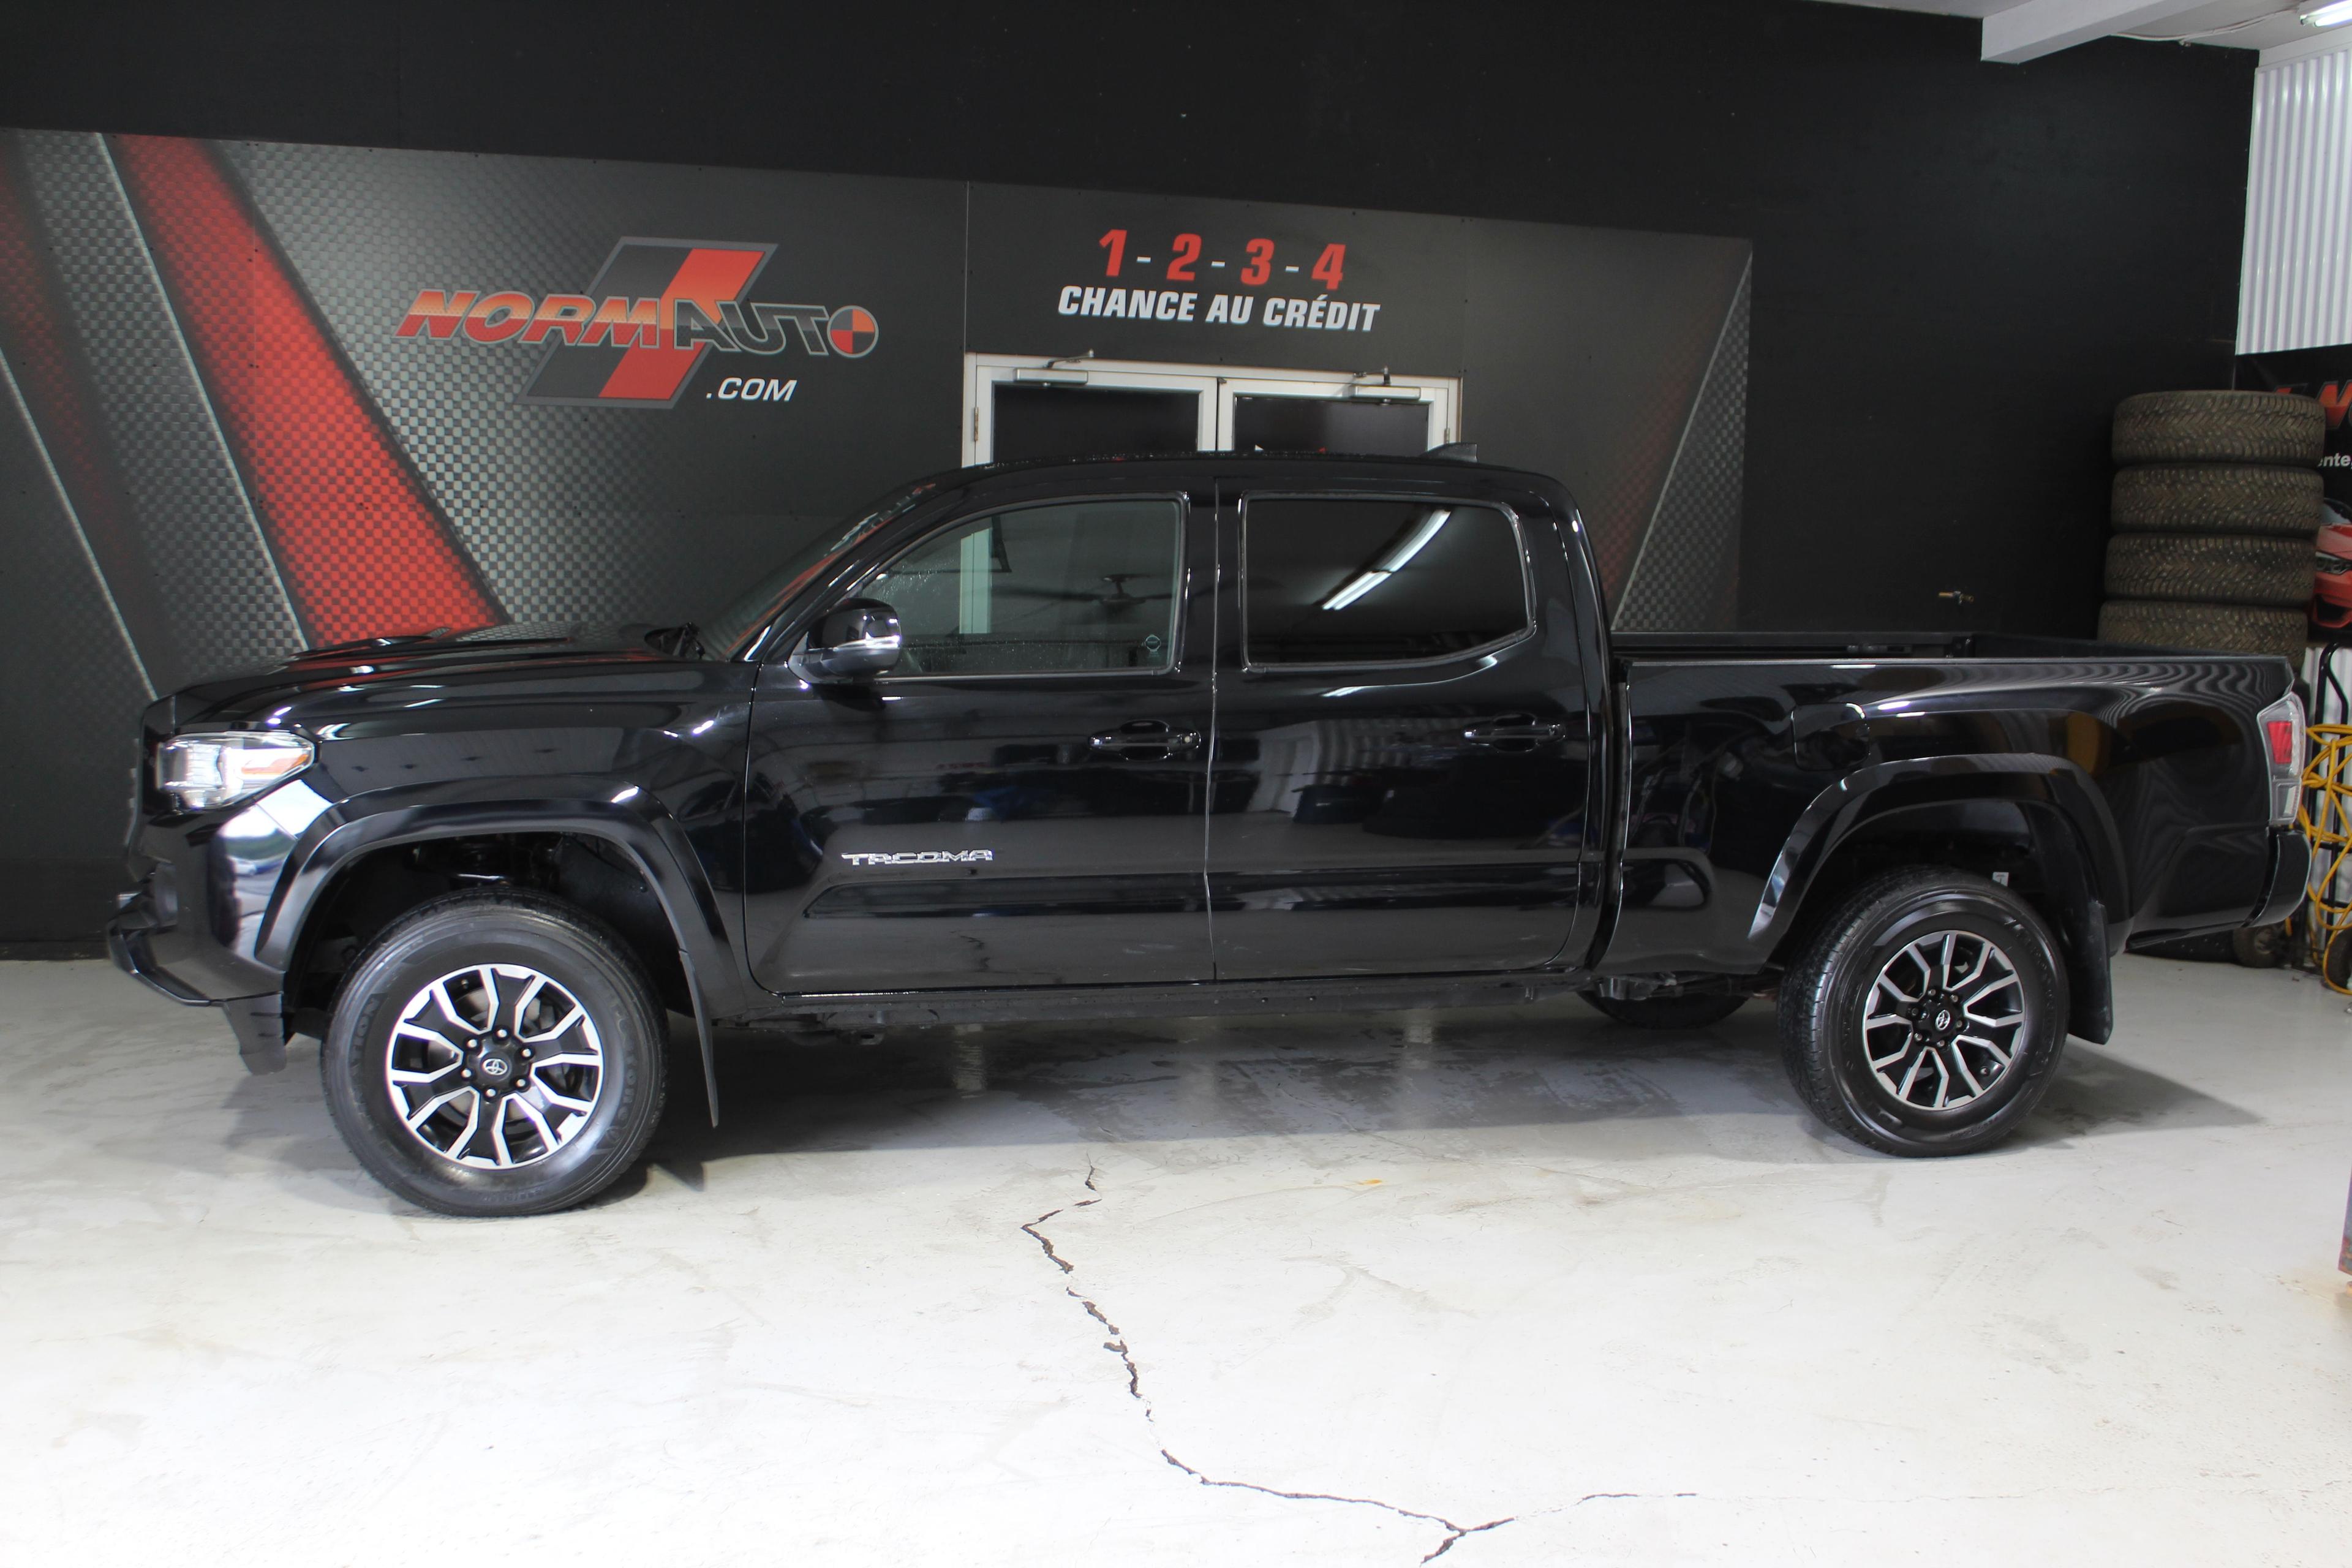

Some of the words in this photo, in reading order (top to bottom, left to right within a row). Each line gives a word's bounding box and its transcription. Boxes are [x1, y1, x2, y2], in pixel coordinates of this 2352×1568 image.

[391, 288, 880, 358] NORMAUTO
[1058, 285, 1198, 322] CHANCE
[1205, 294, 1254, 325] AU
[1262, 295, 1381, 331] CRÉDIT
[706, 377, 798, 402] .COM
[841, 849, 994, 865] TACOMA
